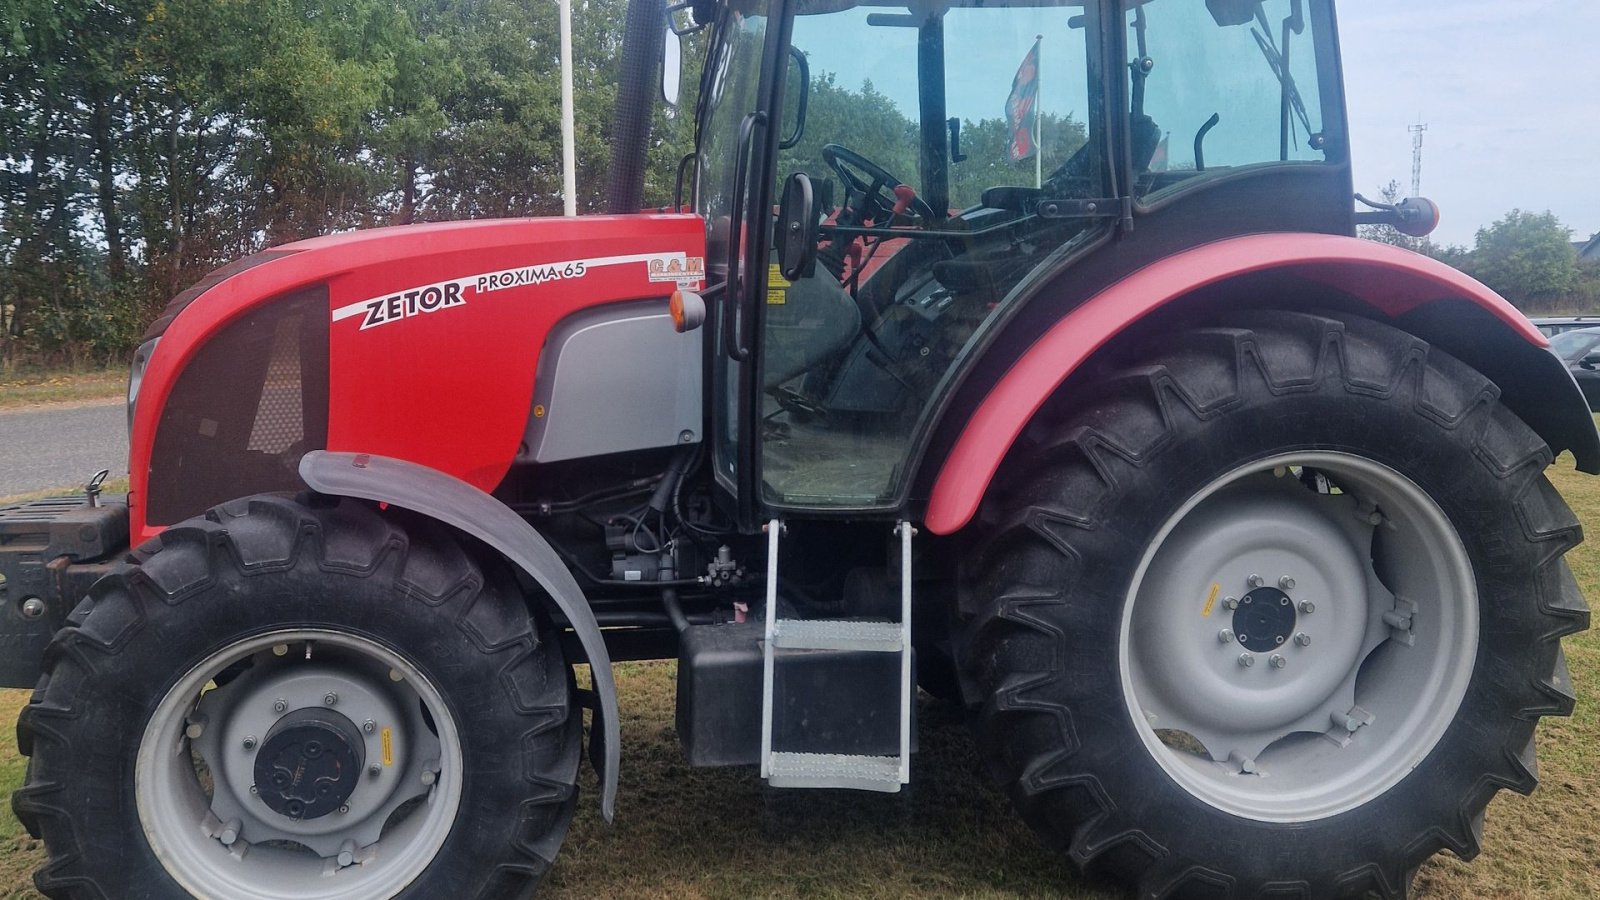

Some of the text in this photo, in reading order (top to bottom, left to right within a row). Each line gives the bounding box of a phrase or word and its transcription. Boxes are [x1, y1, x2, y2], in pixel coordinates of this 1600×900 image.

[667, 258, 682, 273] &
[686, 258, 702, 272] M
[365, 262, 585, 326] ZETOR PROXIMA 65
